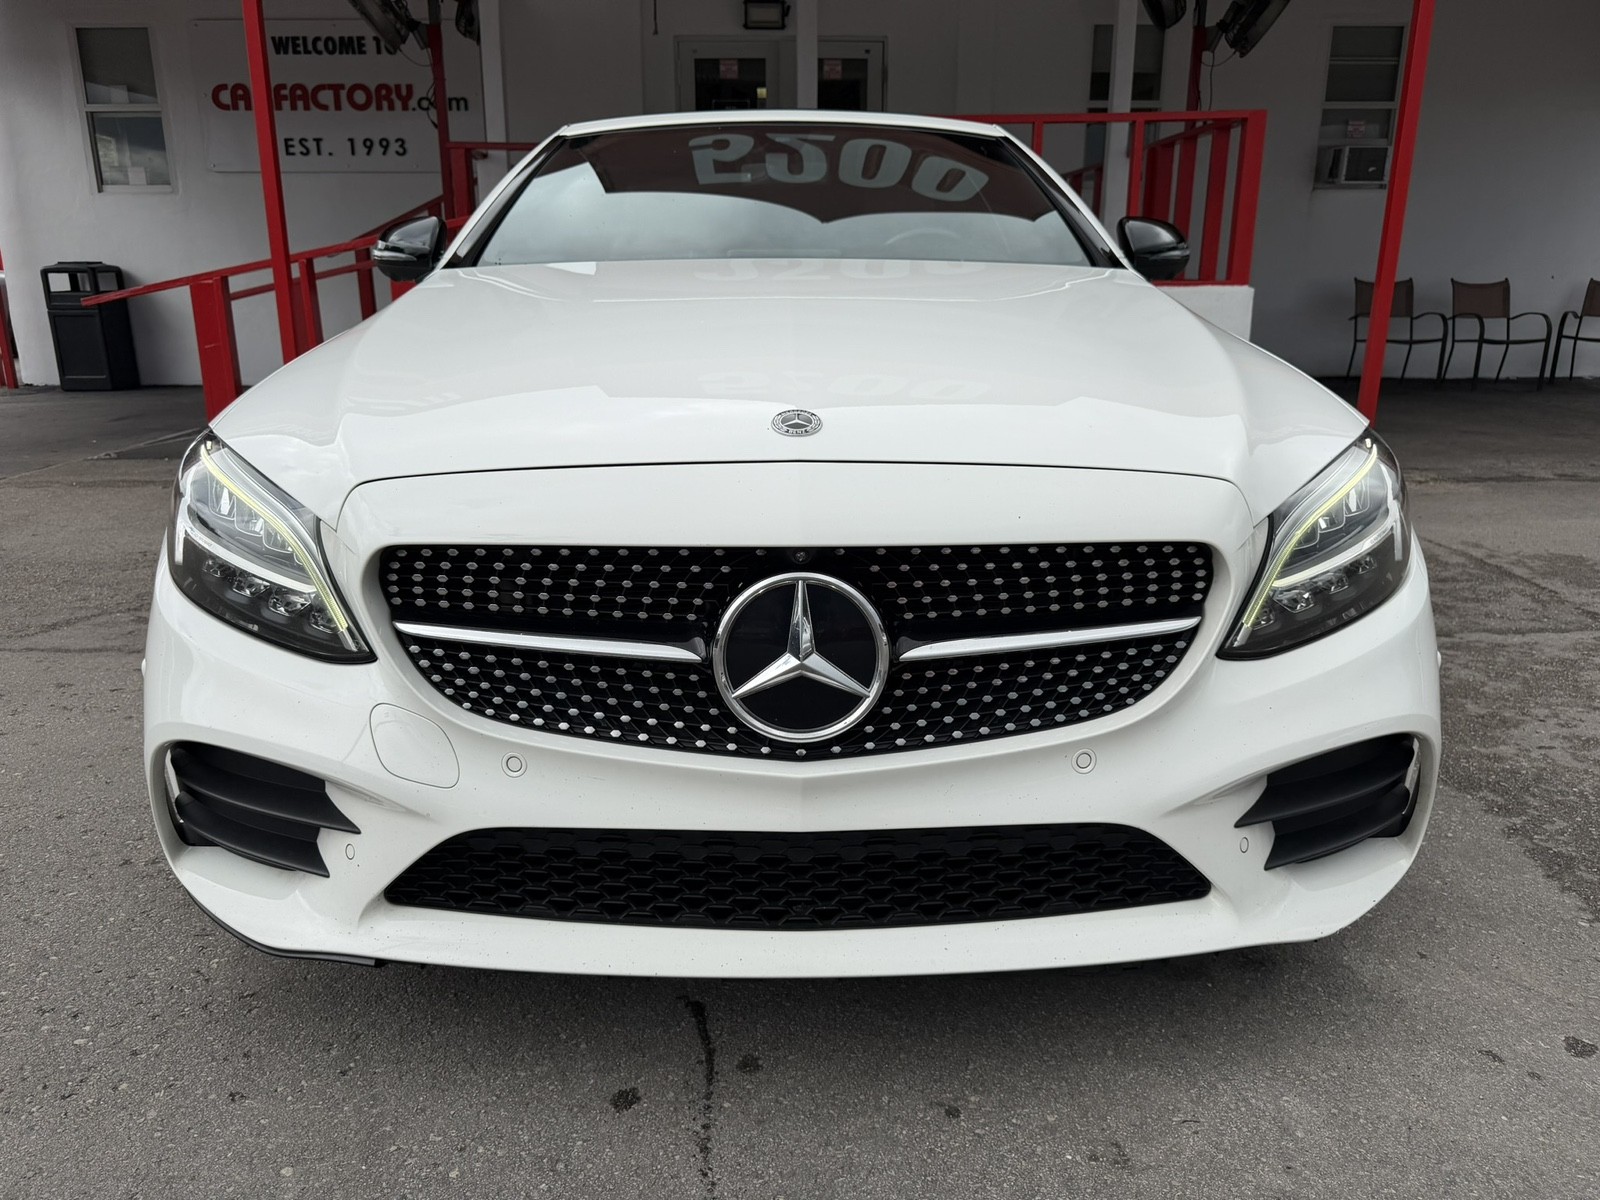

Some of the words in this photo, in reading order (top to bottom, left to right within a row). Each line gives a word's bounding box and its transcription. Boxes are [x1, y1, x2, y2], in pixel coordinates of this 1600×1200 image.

[271, 36, 367, 55] WELCOME
[211, 82, 469, 113] CAFACTORY.cm
[284, 137, 333, 156] EST.
[347, 137, 408, 156] 1993
